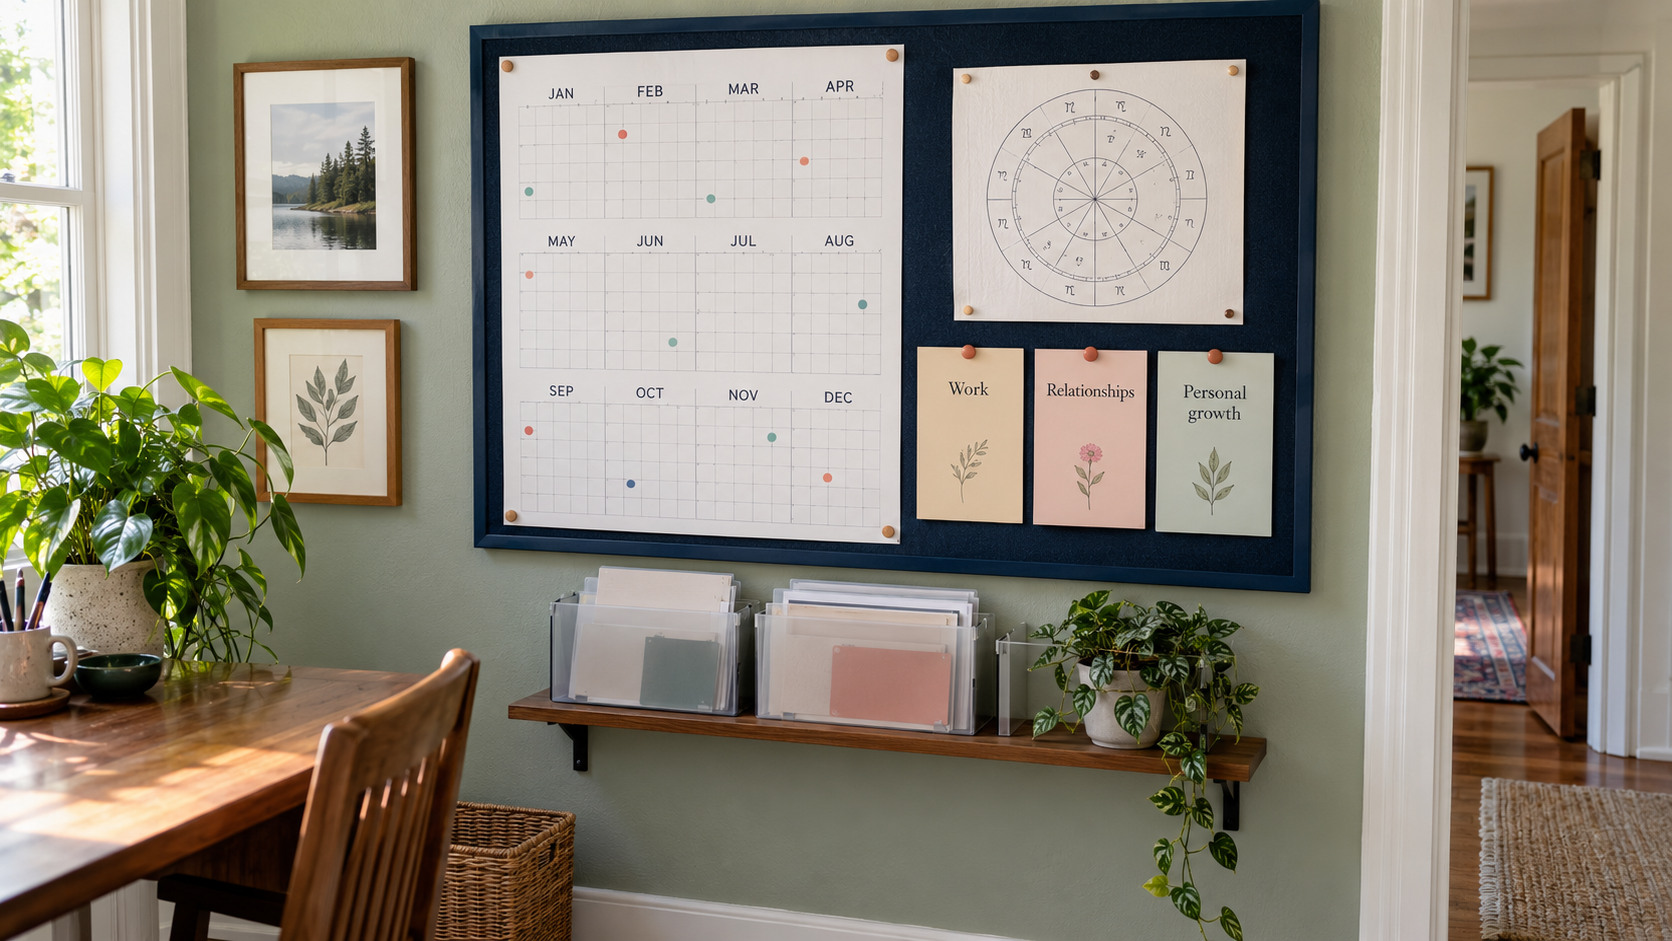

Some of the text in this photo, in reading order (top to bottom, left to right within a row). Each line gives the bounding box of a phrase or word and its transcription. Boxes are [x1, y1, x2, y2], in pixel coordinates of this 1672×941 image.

[637, 85, 663, 98] FEB
[728, 82, 759, 95] MAR
[825, 80, 855, 93] APR
[548, 87, 574, 100] JAN
[548, 235, 576, 247] MAY
[636, 235, 663, 247] JUN
[730, 235, 757, 247] JUL
[824, 234, 854, 247] AUG
[549, 384, 574, 397] SEP
[635, 386, 664, 399] OCT
[948, 381, 989, 396] Work
[1046, 382, 1135, 402] Relationships
[1184, 384, 1246, 400] Personal
[728, 389, 759, 402] NOV
[824, 391, 853, 404] DEC
[1188, 405, 1241, 424] growth
